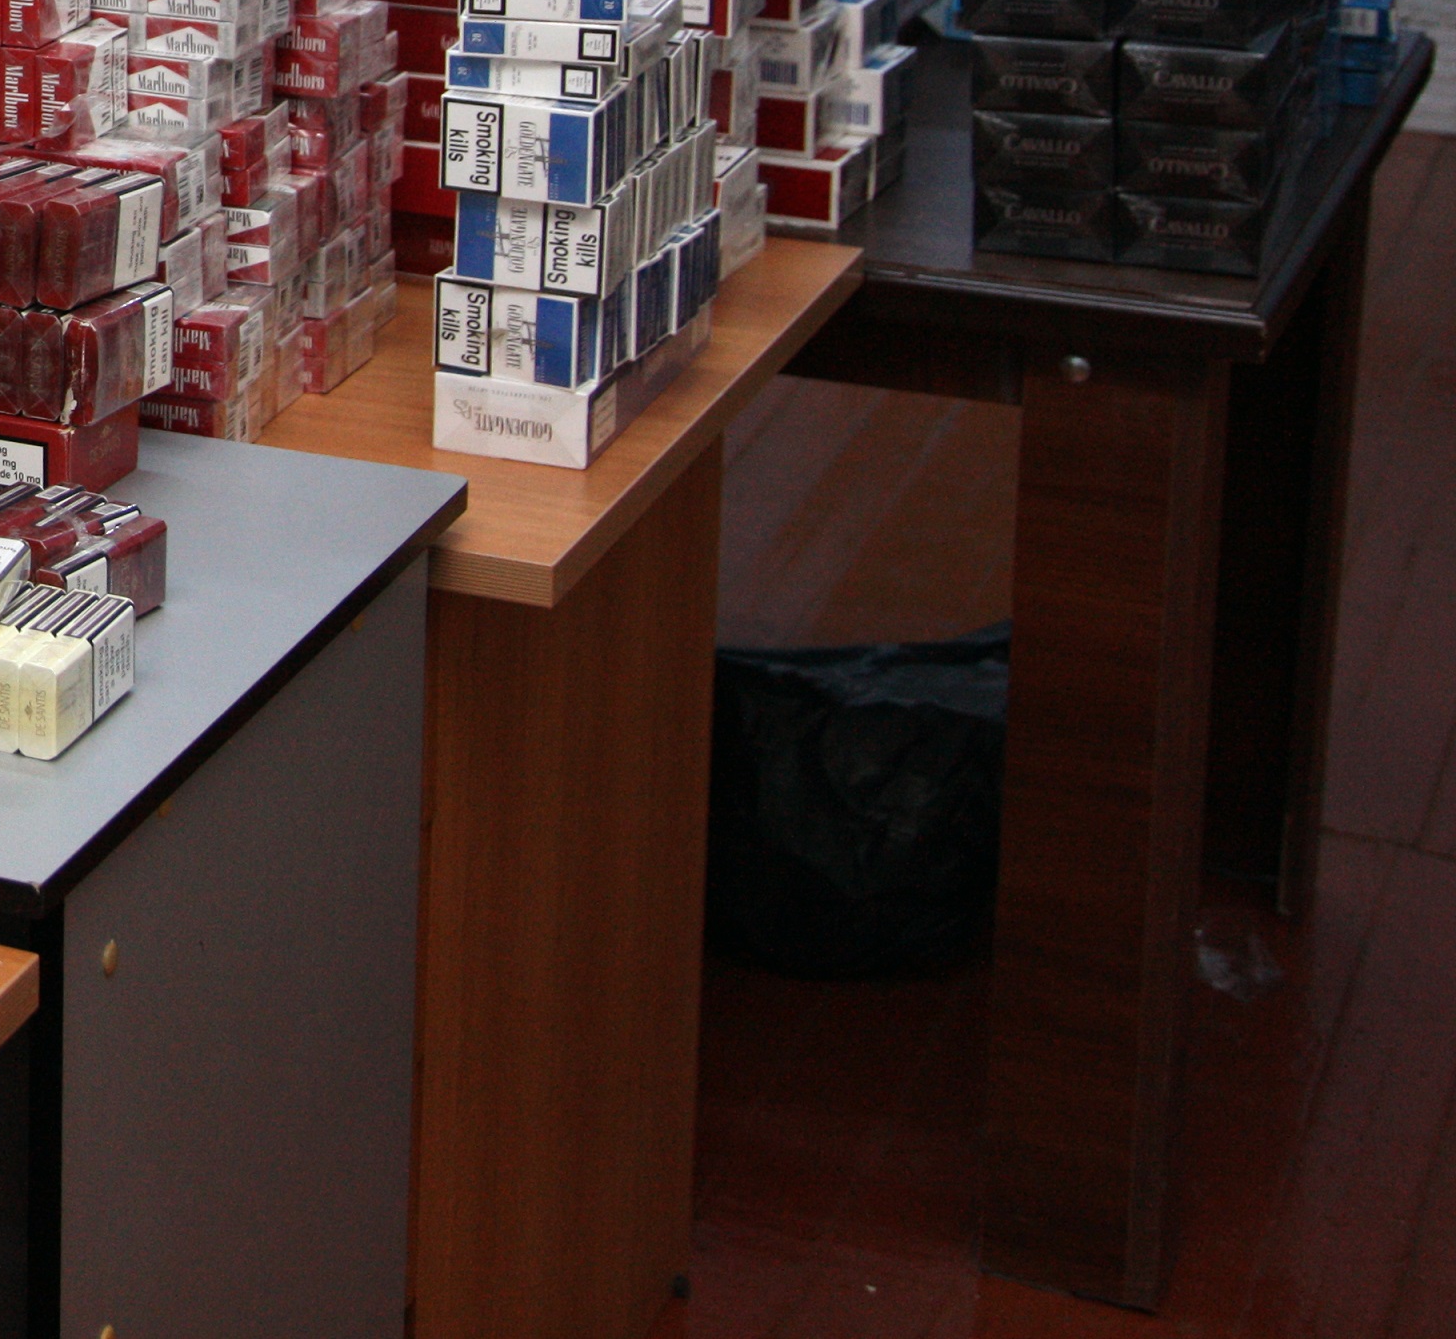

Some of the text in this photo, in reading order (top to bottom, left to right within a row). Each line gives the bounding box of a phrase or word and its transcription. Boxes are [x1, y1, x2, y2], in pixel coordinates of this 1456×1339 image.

[448, 129, 469, 163] kills
[470, 111, 496, 186] Smoking
[547, 209, 576, 284] Smoking
[576, 233, 597, 268] kills
[161, 309, 169, 335] kill
[442, 307, 460, 341] kills
[462, 292, 486, 366] Smoking
[147, 305, 159, 390] Smoking
[2, 459, 16, 469] mg
[14, 472, 24, 482] 10
